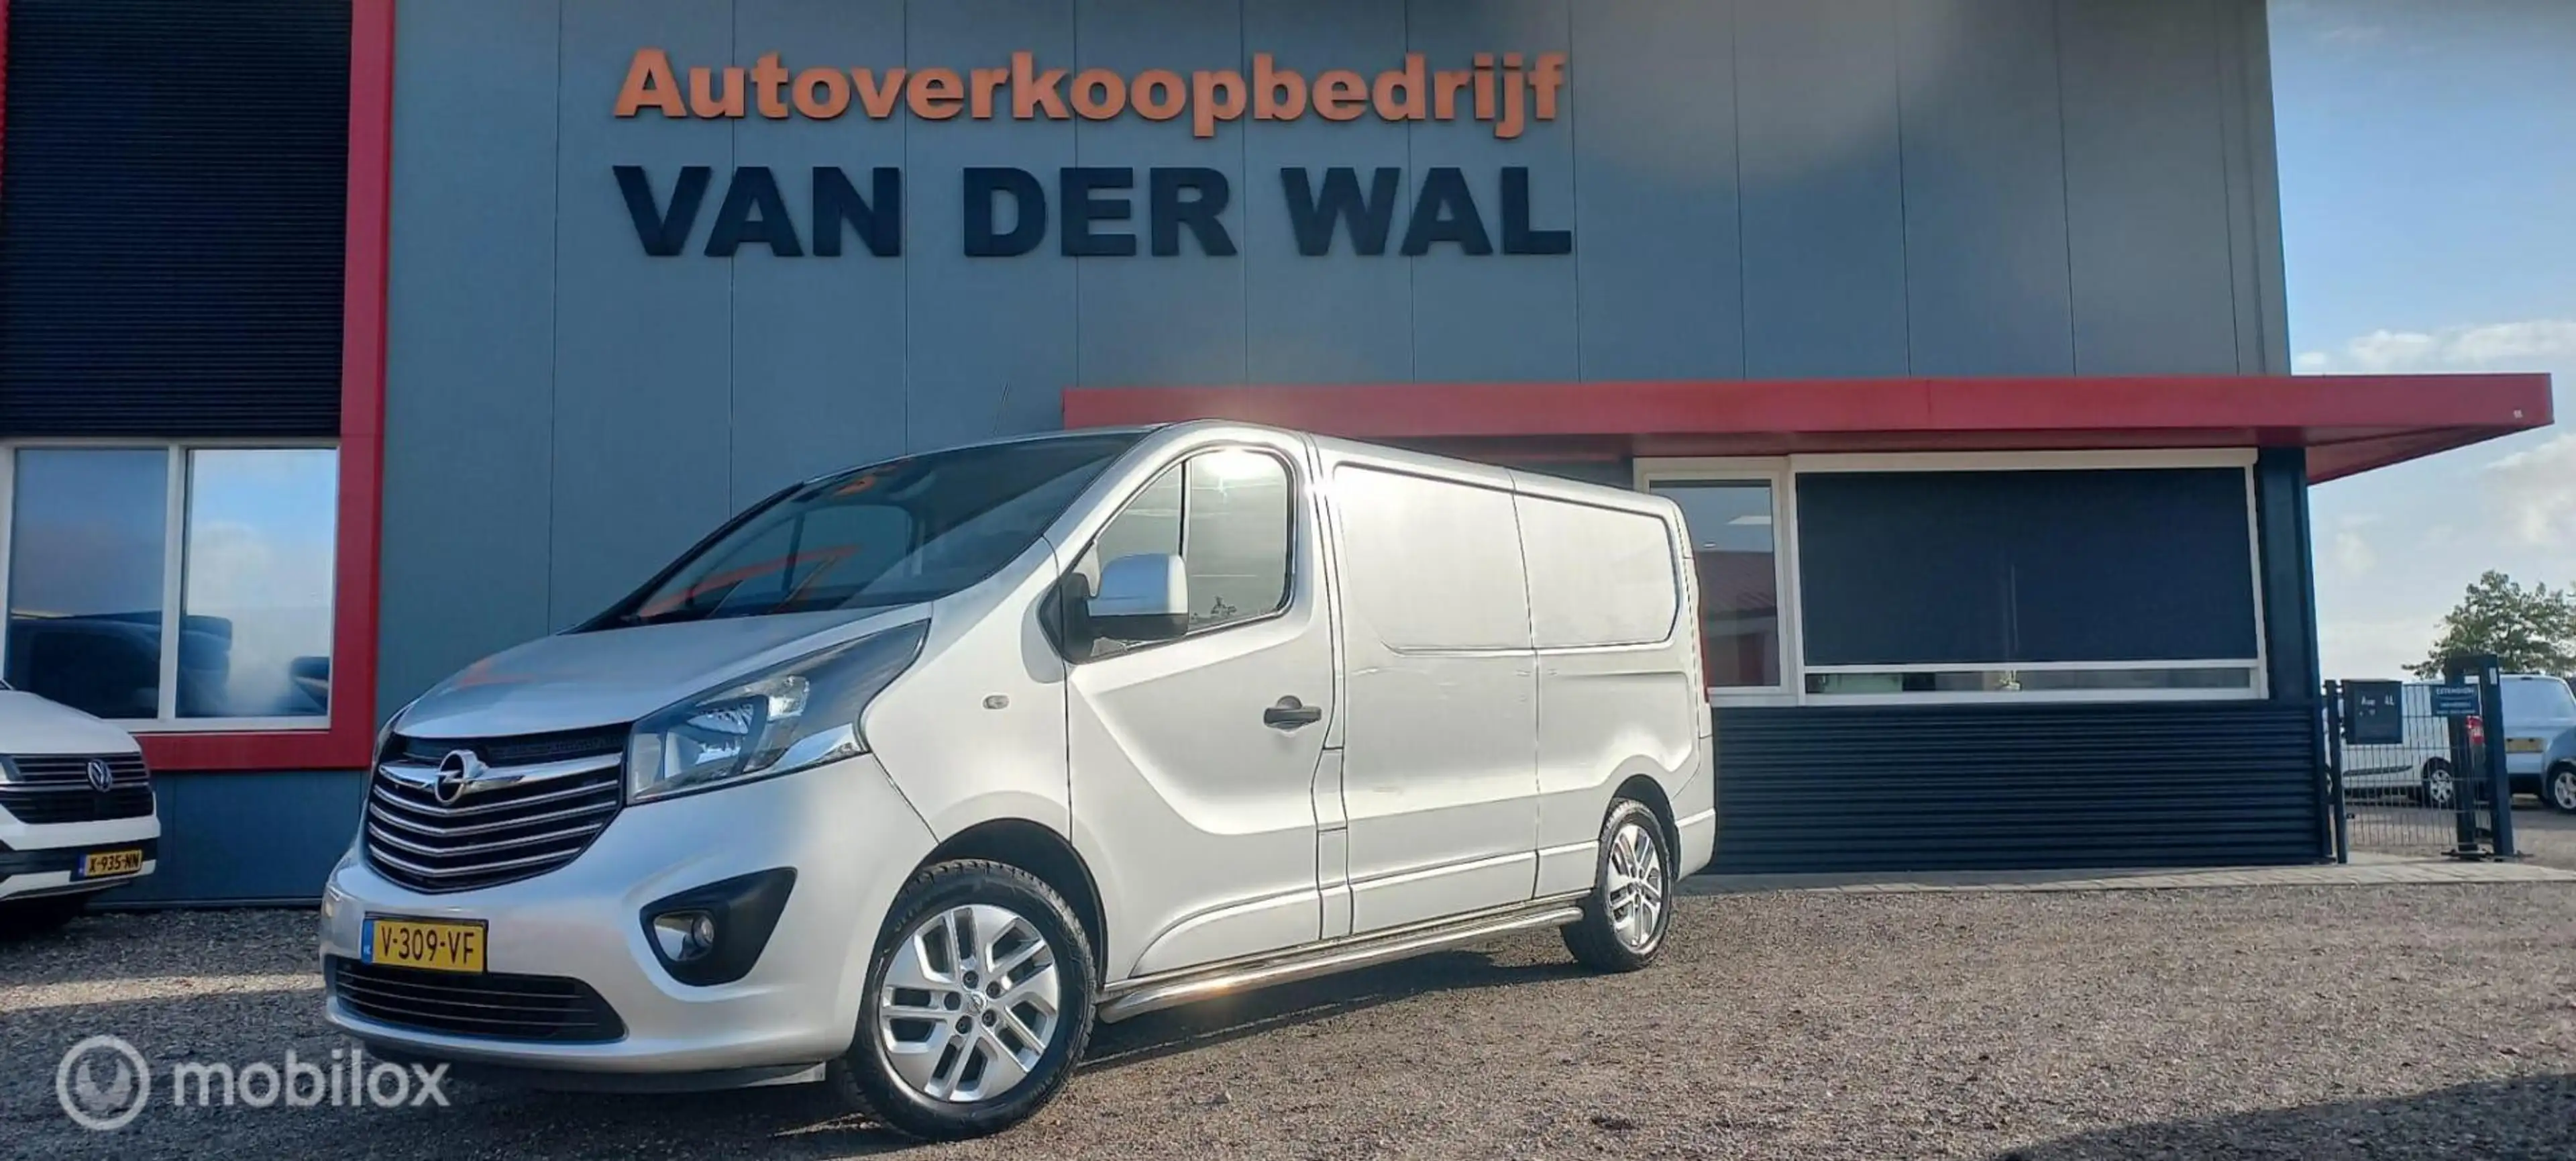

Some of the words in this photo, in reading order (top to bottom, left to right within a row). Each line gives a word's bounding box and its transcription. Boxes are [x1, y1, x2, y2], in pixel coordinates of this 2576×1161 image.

[614, 48, 1566, 138] Autoverkoopbedrijf
[612, 166, 903, 258] VAN
[963, 166, 1238, 259] DER
[1279, 166, 1573, 258] WAL
[89, 853, 140, 873] X-935-NN
[381, 925, 474, 964] V-309-VF
